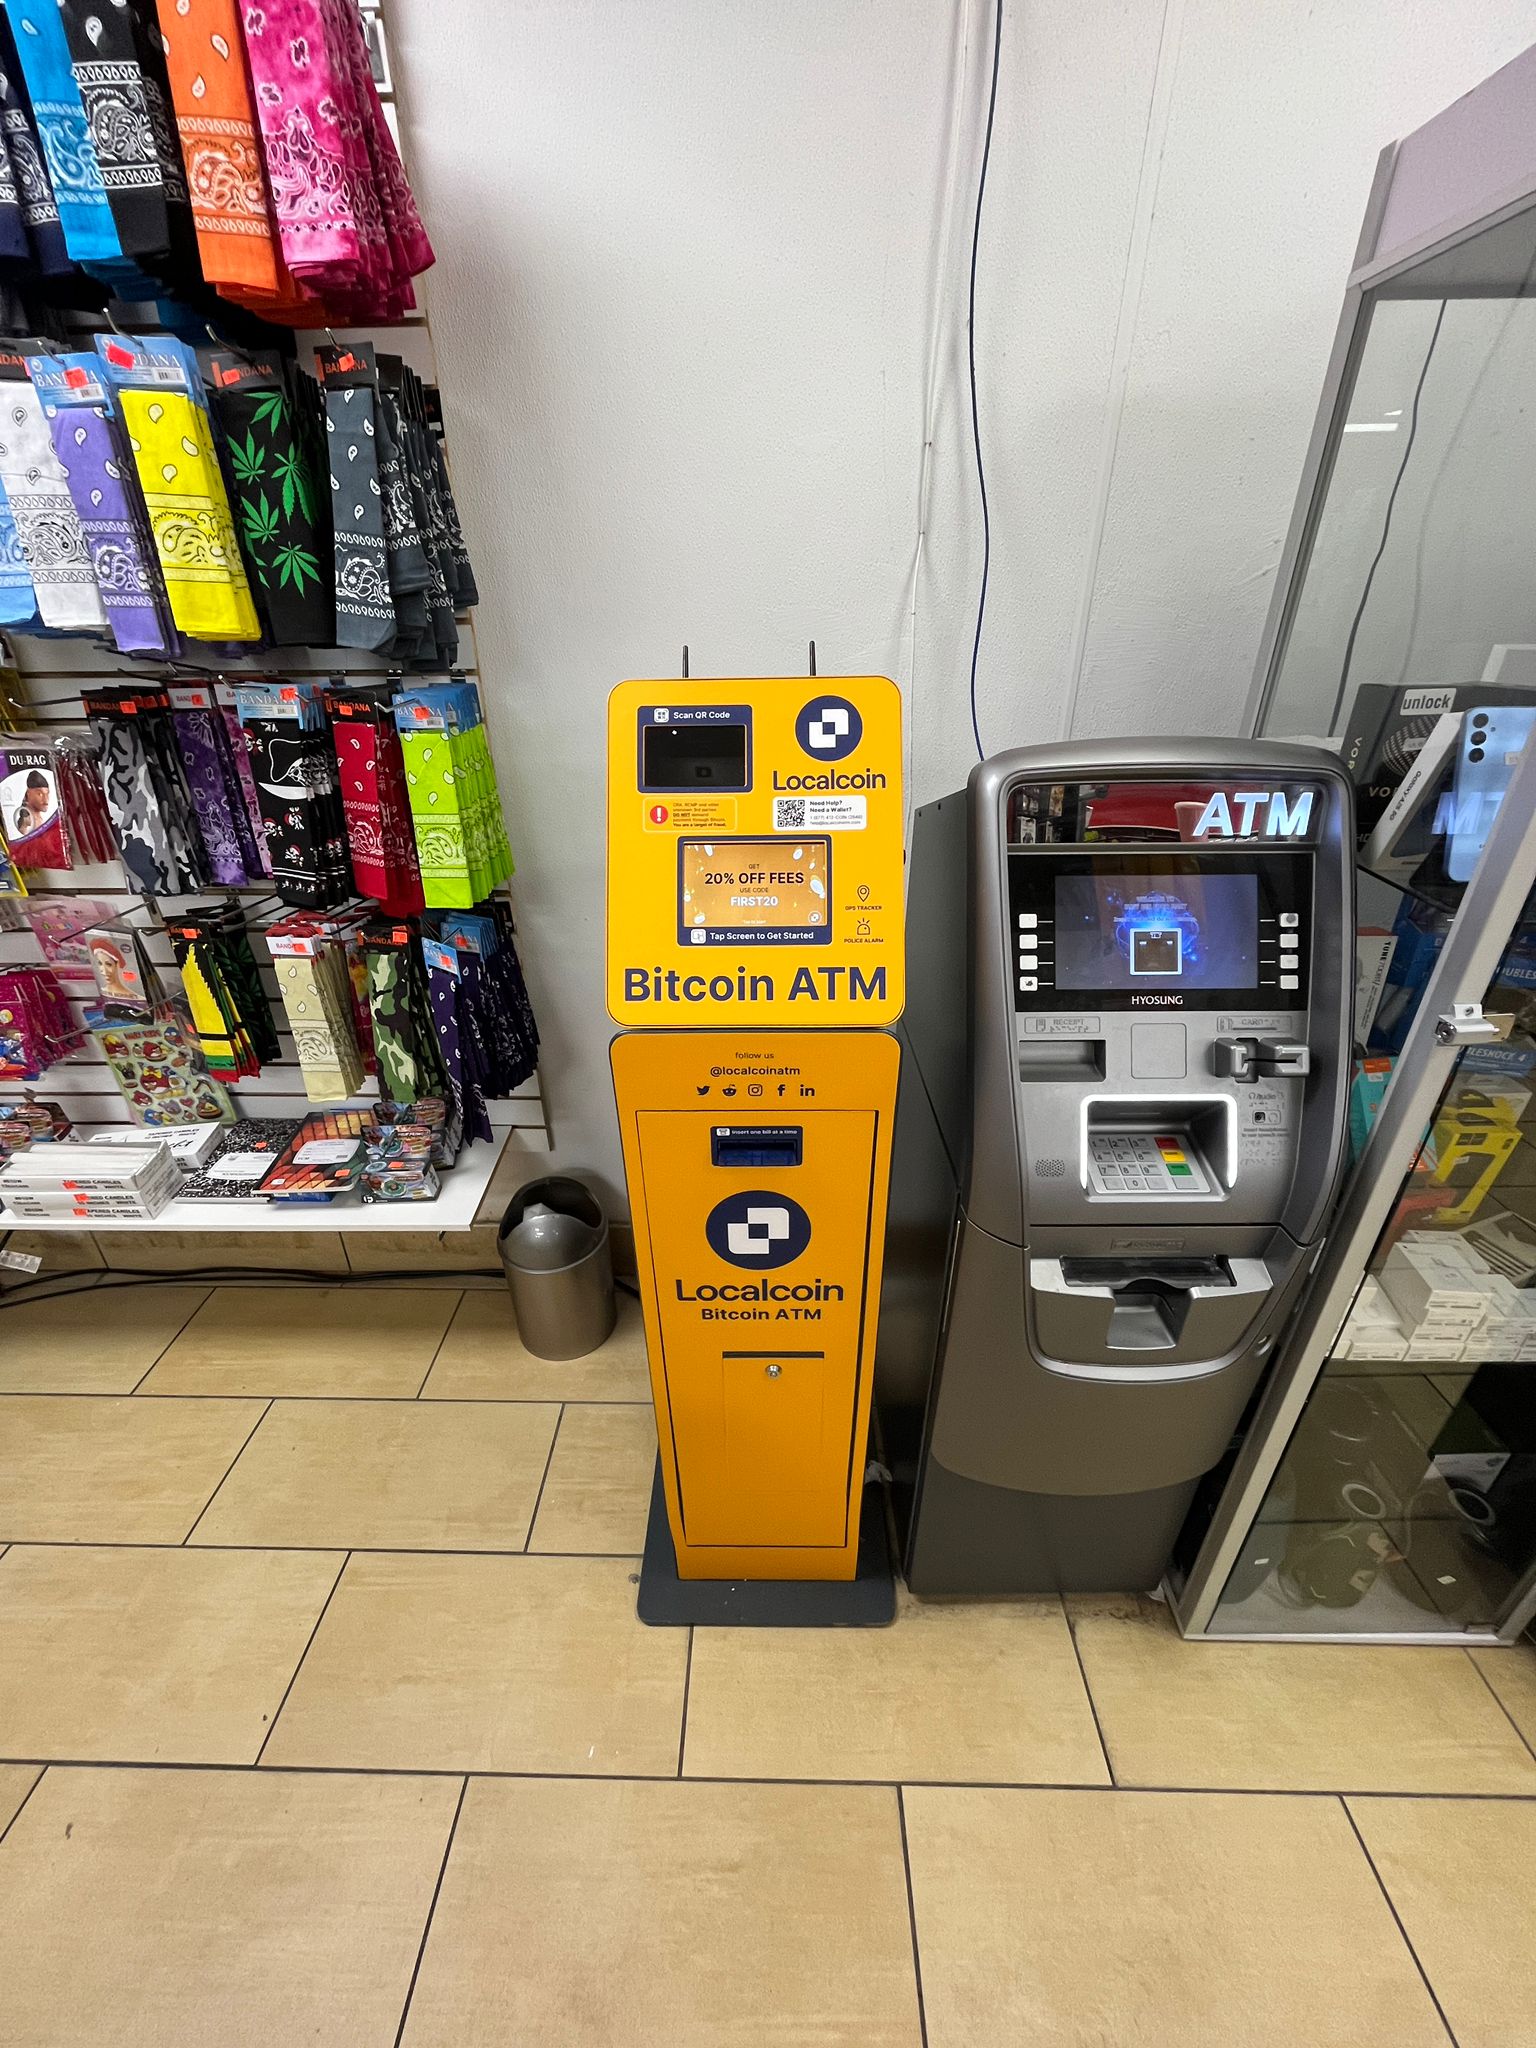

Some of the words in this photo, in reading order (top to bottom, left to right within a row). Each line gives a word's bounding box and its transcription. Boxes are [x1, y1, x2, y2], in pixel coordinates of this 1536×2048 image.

[1403, 693, 1451, 710] unlock
[673, 711, 694, 719] Scan
[695, 711, 707, 719] QR
[708, 711, 730, 719] Code
[9, 755, 47, 766] DU-RAG
[773, 768, 886, 791] Localcoin
[1192, 791, 1314, 837] ATM
[705, 872, 735, 885] 20%
[738, 872, 766, 884] OFF
[769, 872, 804, 884] FEES
[730, 896, 779, 907] FIRST20
[709, 932, 724, 941] Tap
[726, 932, 755, 940] Screen
[757, 932, 766, 940] to
[767, 932, 782, 940] Get
[624, 966, 774, 1001] Bitcoin
[787, 966, 887, 1001] ATM
[1131, 995, 1184, 1005] HYOSUNG
[735, 1051, 762, 1059] follow
[710, 1065, 800, 1078] @localcoinatm
[675, 1278, 844, 1302] Localcoin
[701, 1307, 770, 1321] Bitcoin
[775, 1308, 821, 1320] ATM
